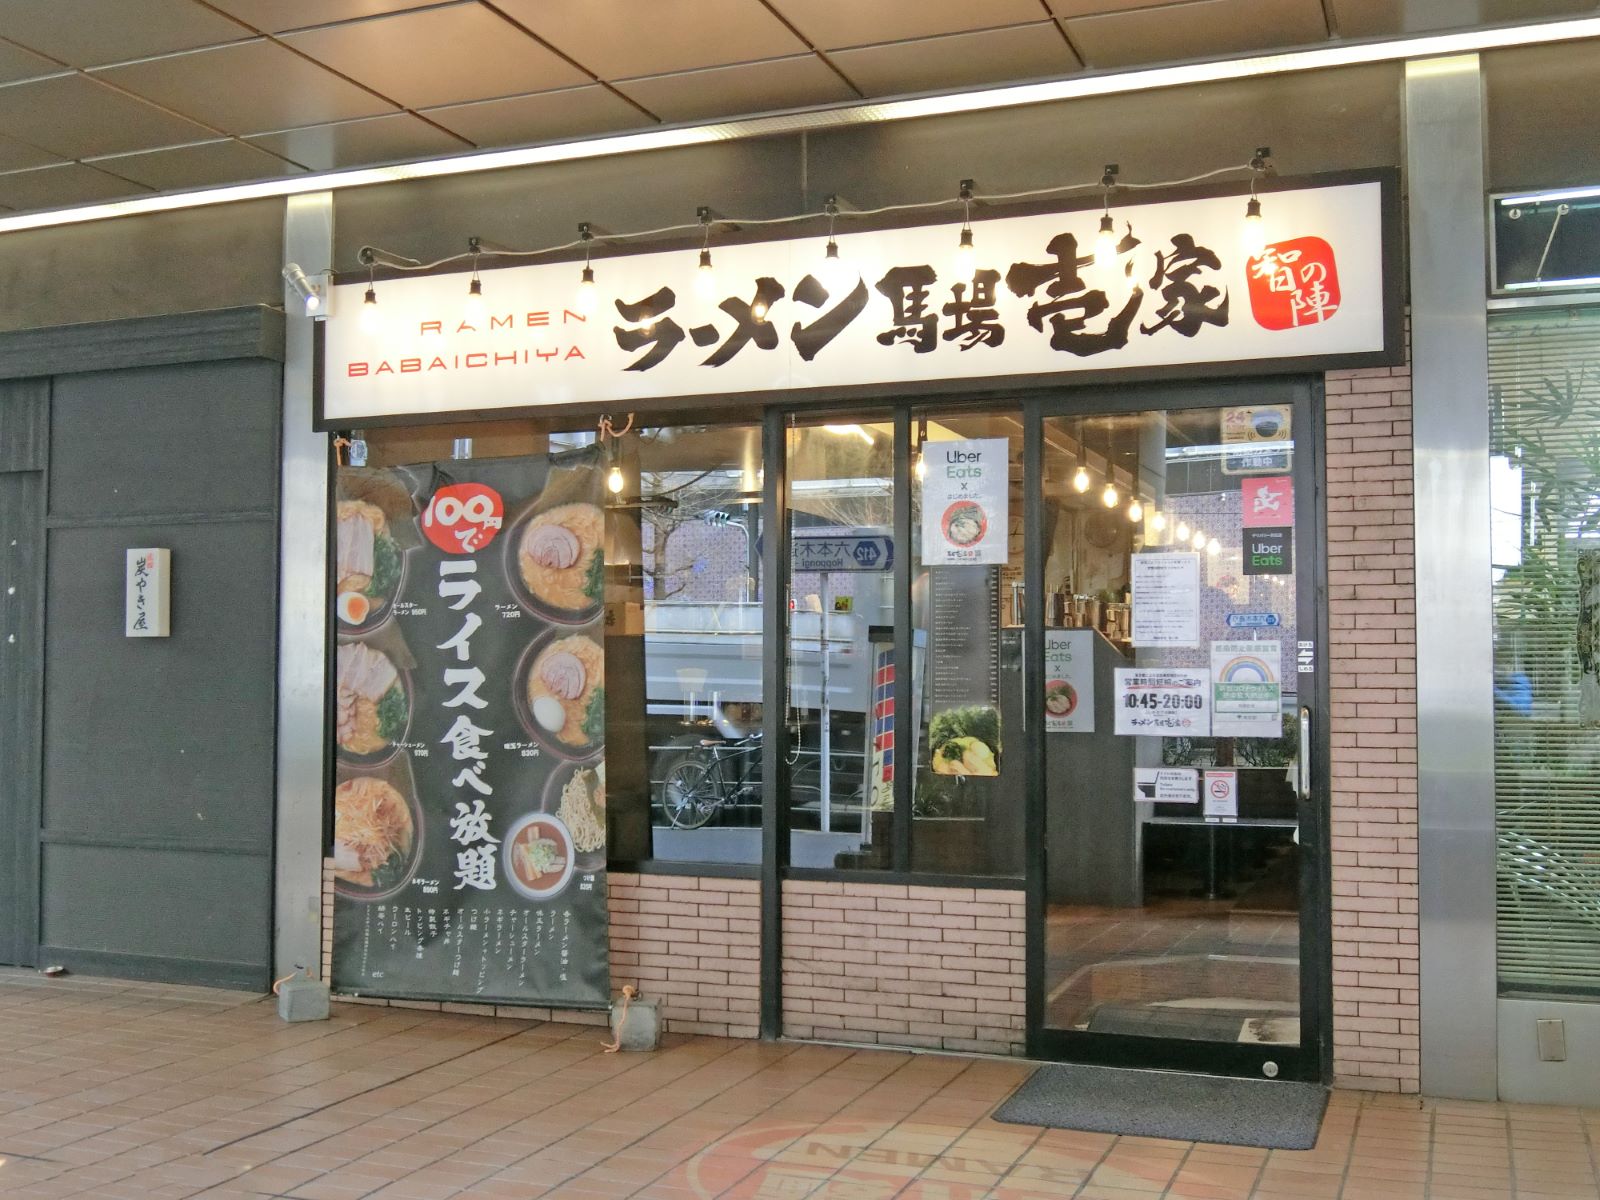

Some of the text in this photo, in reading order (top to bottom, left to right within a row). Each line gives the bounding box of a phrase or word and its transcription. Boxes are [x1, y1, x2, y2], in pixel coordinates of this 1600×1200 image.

[420, 309, 587, 336] RAMEN
[347, 345, 586, 378] BABAICHIYA
[946, 450, 982, 464] Uber
[947, 466, 982, 479] Eats
[1252, 543, 1283, 554] Uber
[1252, 555, 1283, 566] Eats
[494, 603, 518, 611] ラーメン
[436, 559, 502, 890] ライス食べ放題
